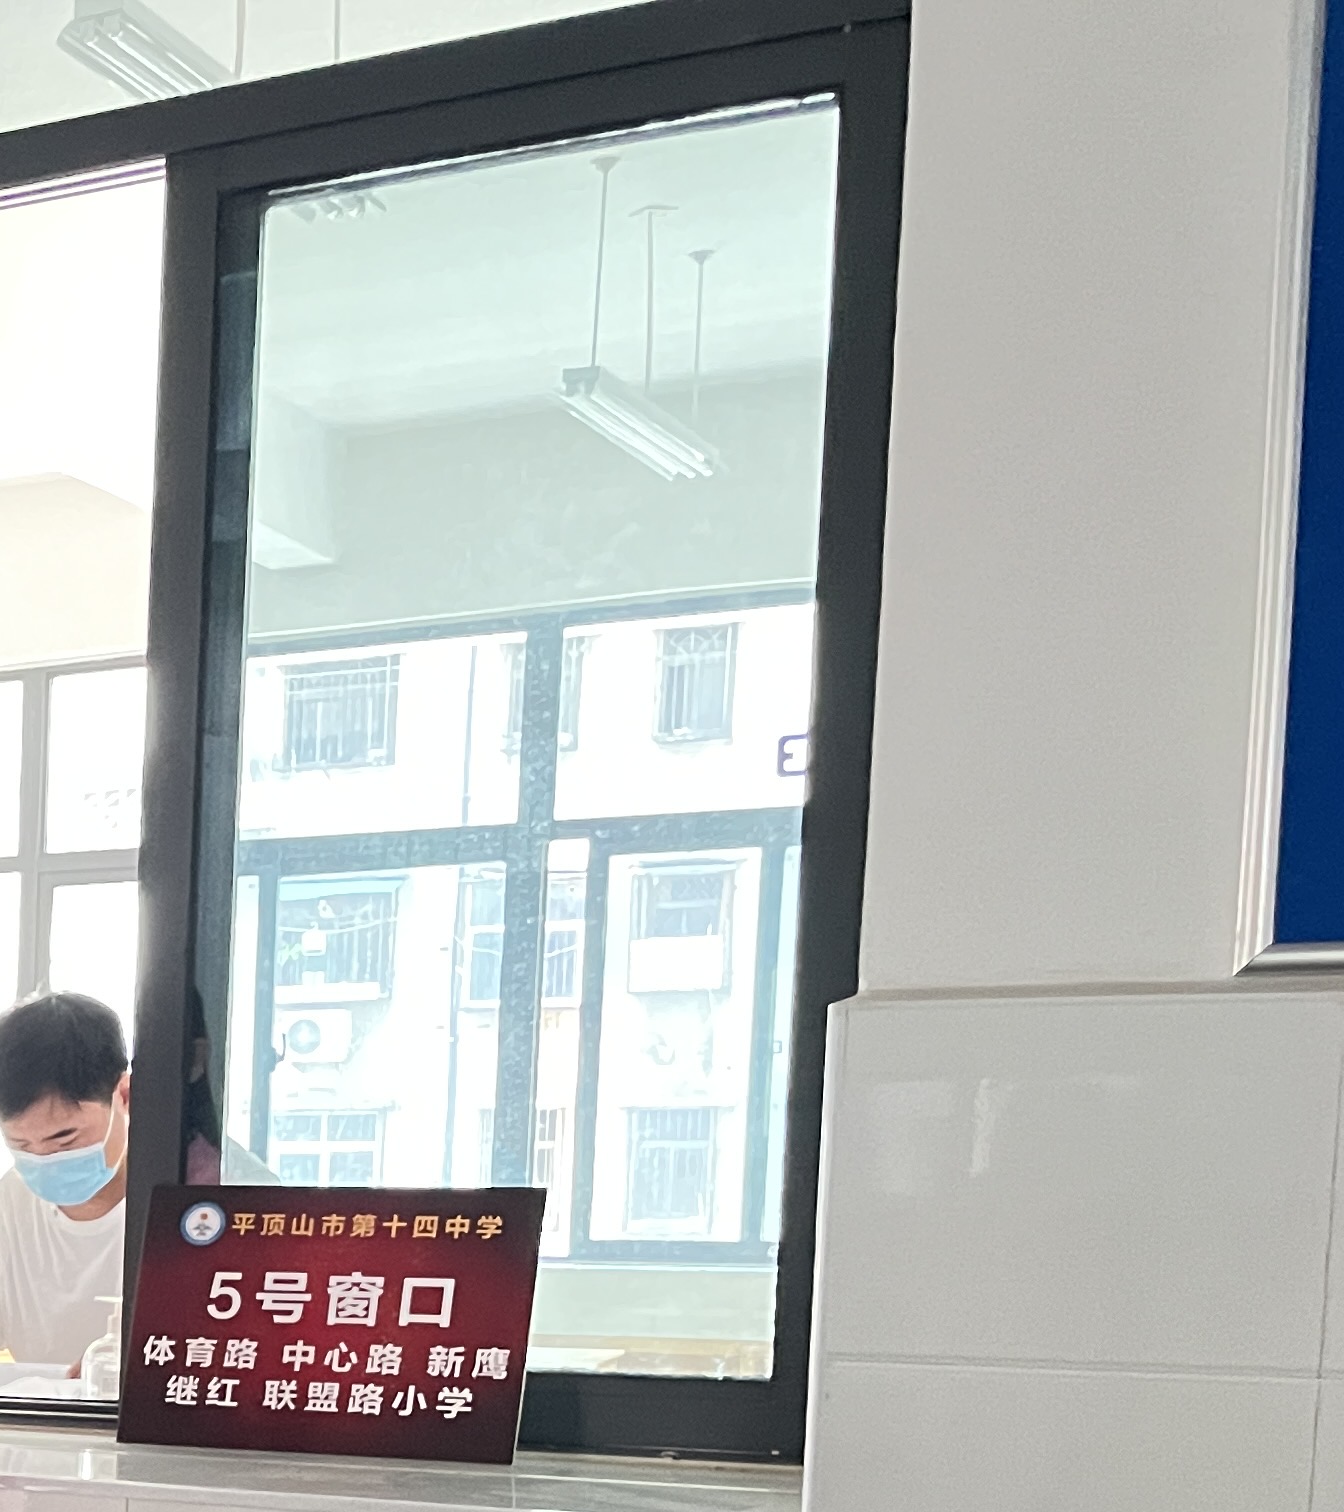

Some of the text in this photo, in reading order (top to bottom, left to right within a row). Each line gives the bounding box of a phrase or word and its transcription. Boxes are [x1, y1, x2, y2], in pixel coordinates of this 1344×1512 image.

[231, 1212, 504, 1240] 平顶山市第十四中学
[205, 1271, 456, 1328] 5号窗口
[142, 1335, 511, 1380] 体育路 中心路 新鹰
[164, 1374, 474, 1419] 继红 联盟路小学
